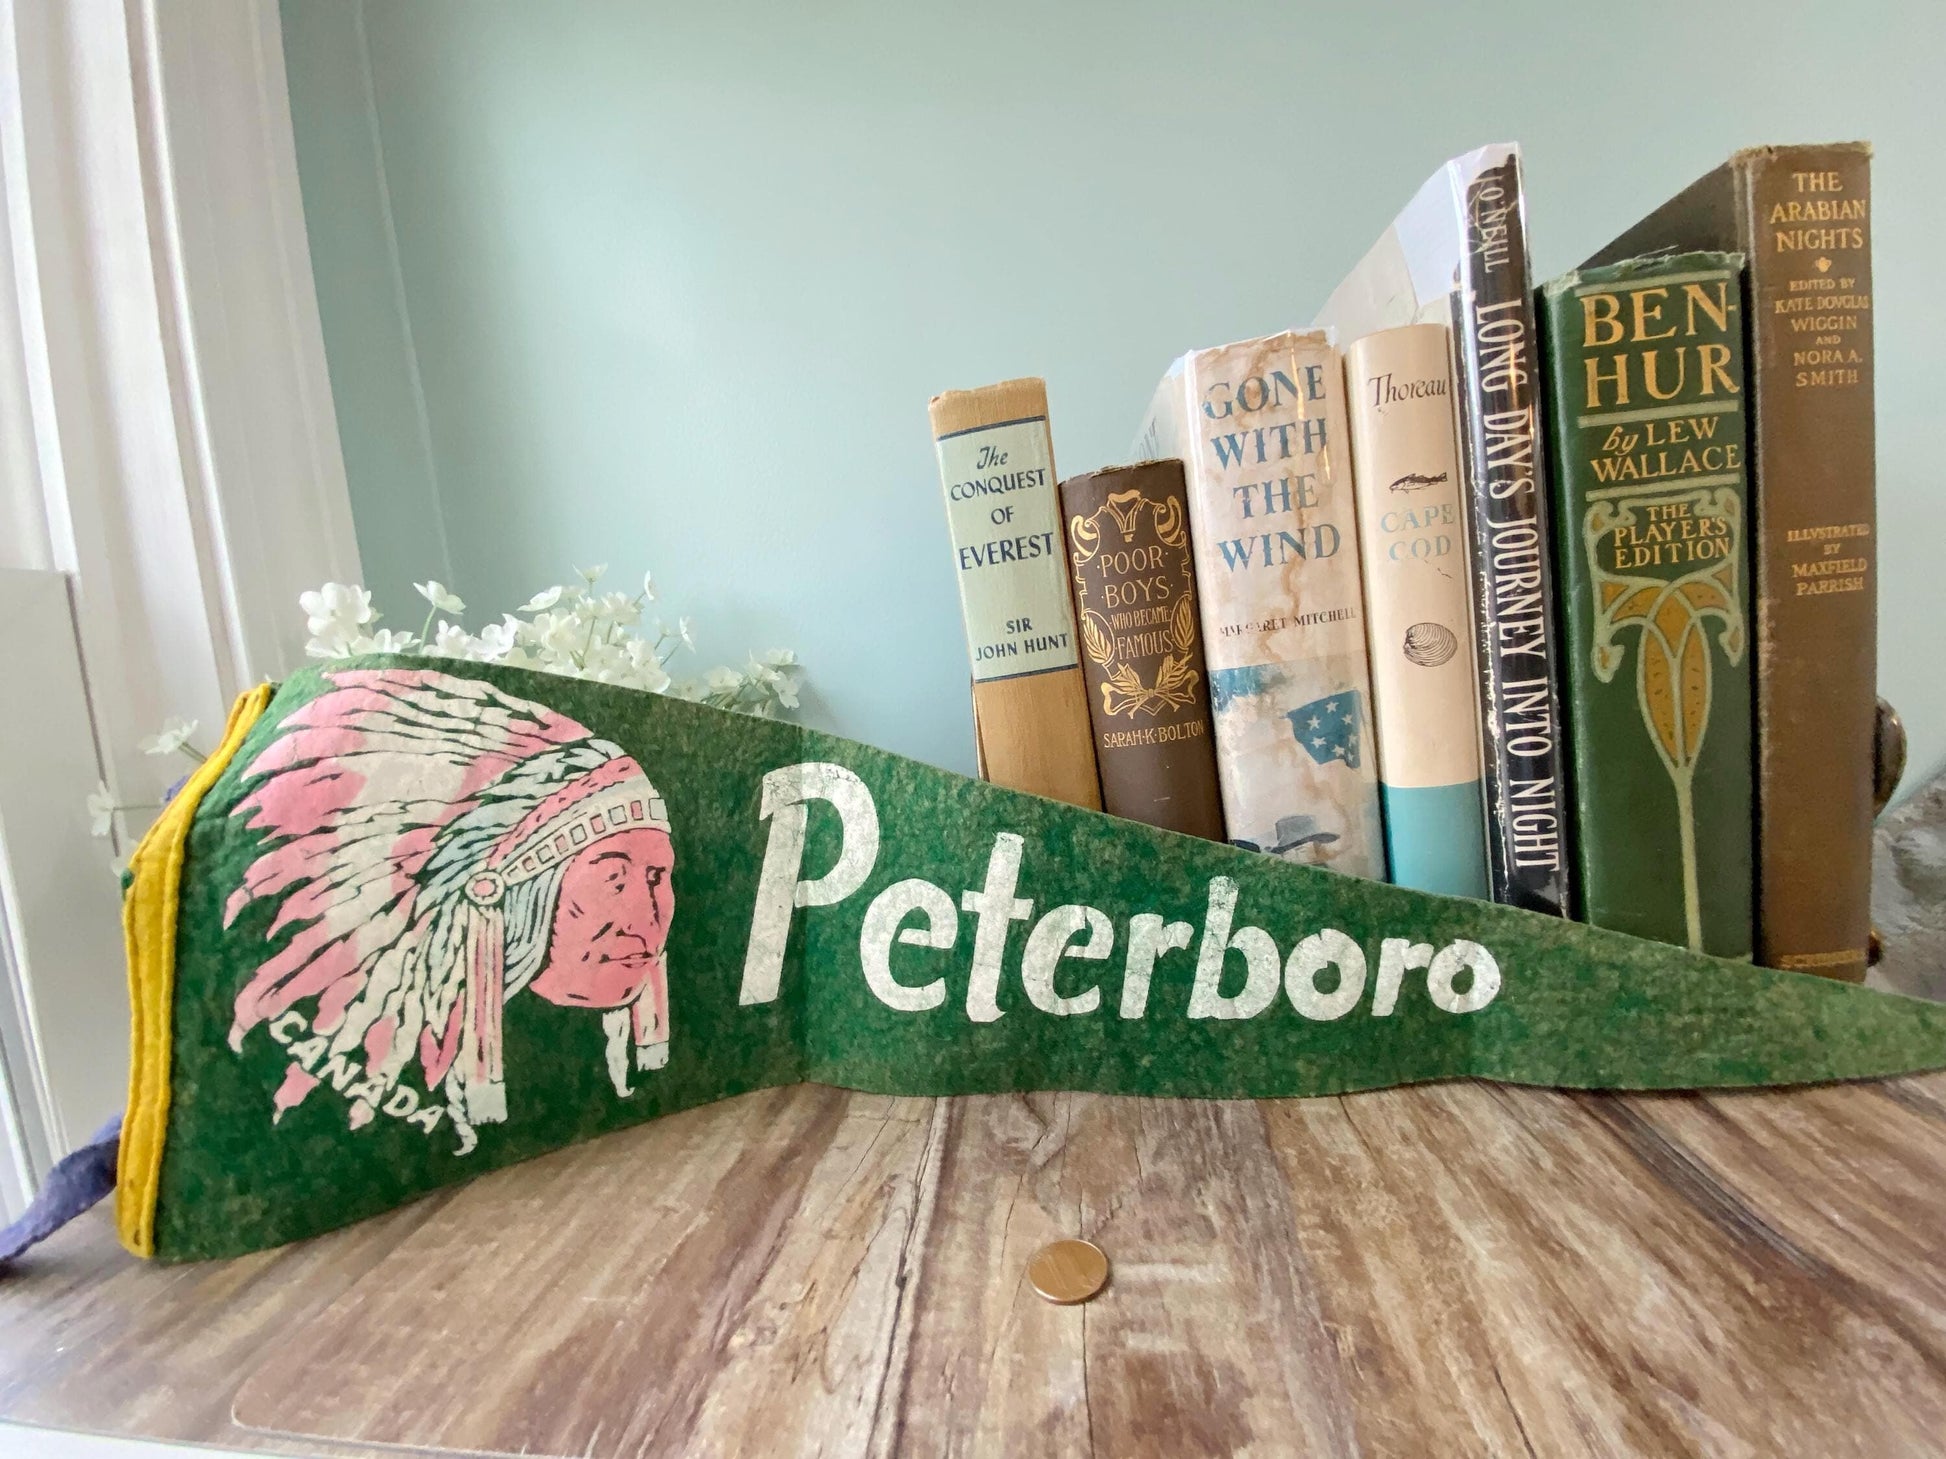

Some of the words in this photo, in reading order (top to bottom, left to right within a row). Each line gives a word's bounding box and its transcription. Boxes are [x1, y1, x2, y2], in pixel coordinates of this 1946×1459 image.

[1793, 172, 1843, 194] THE
[1770, 199, 1866, 225] ARABIAN
[1776, 227, 1863, 252] NIGHTS
[1789, 279, 1836, 292] EDITED
[1840, 277, 1856, 289] BY
[1774, 297, 1814, 314] KATE
[1791, 315, 1858, 332] WIGGIN
[1475, 299, 1530, 391] LONG
[1815, 335, 1841, 345] AND
[1793, 350, 1843, 367] NORA
[1848, 349, 1863, 363] A.
[1367, 371, 1447, 408] Thoreau
[1585, 342, 1741, 409] HUR
[1795, 369, 1859, 387] SMITH
[1201, 365, 1327, 420] GONE
[1210, 417, 1329, 471] WITH
[1603, 424, 1639, 457] by
[1645, 416, 1719, 446] LEW
[976, 446, 1008, 469] The
[1483, 406, 1536, 500] DAY'S
[1590, 444, 1742, 484] WALLACE
[950, 468, 1046, 502] CONQUEST
[1232, 475, 1320, 519] THE
[990, 506, 1015, 524] OF
[1380, 502, 1456, 534] CAPE
[1646, 502, 1691, 521] THE
[1613, 516, 1728, 547] PLAYER'S
[959, 532, 1054, 571] EVEREST
[1100, 545, 1165, 578] POOR
[1216, 523, 1342, 573] WIND
[1389, 535, 1453, 563] COD
[1614, 539, 1731, 569] EDITION
[1823, 543, 1841, 555] BY
[1791, 558, 1867, 578] MAXFIELD
[1105, 576, 1170, 609] BOYS
[1486, 516, 1548, 660] JOURNEY
[1796, 576, 1864, 596] PARRISH
[1006, 617, 1033, 635] SIR
[1111, 612, 1132, 630] WHO
[1134, 605, 1170, 627] BECAME
[1294, 606, 1357, 628] MITCHELL
[975, 642, 1018, 662] JOHN
[1024, 633, 1069, 655] HUNT
[1116, 630, 1174, 660] FAMOUS
[1502, 676, 1553, 757] INTO
[1509, 775, 1561, 872] NIGHT
[739, 762, 1502, 1023] Peterboro
[268, 1010, 445, 1134] CANADA
